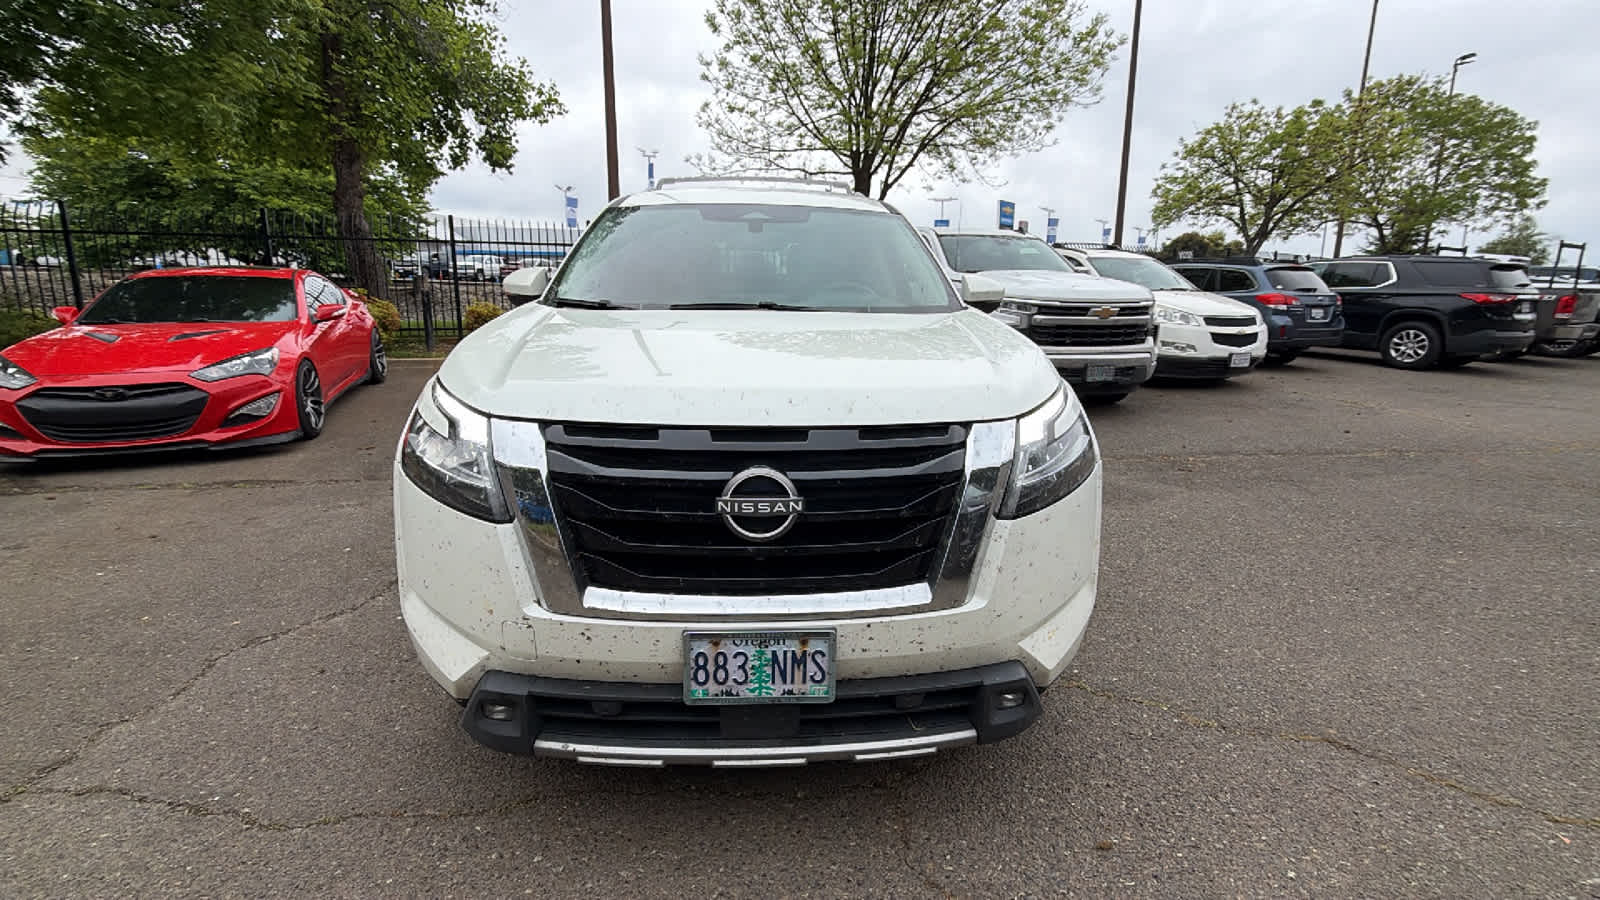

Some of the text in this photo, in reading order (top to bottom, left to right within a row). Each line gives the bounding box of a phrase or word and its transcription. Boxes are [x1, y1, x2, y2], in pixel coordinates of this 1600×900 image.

[718, 501, 803, 513] NISSAN
[693, 650, 826, 686] 883 NMS
